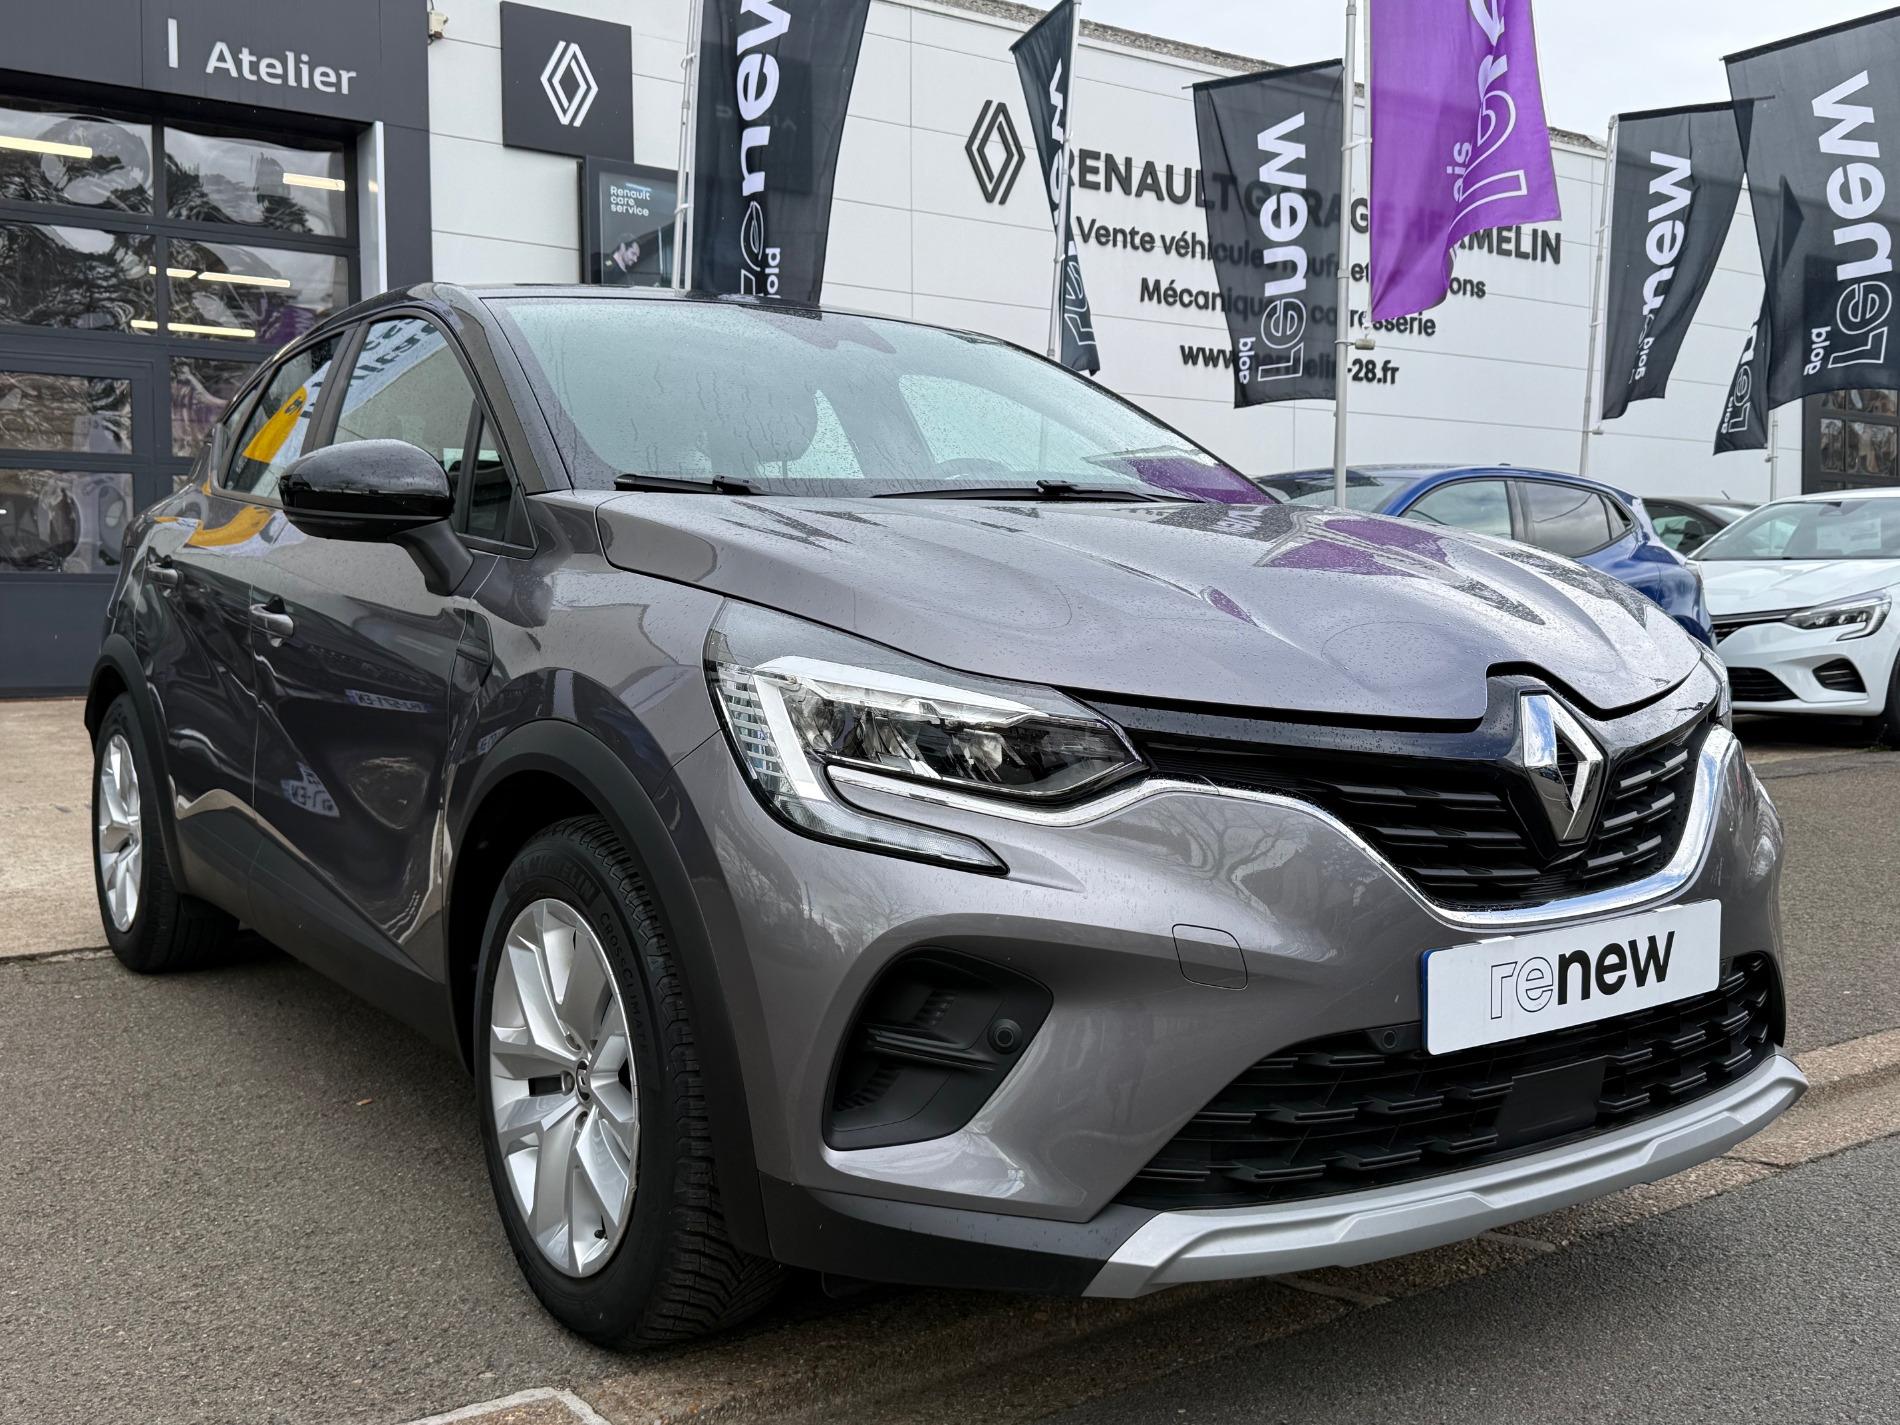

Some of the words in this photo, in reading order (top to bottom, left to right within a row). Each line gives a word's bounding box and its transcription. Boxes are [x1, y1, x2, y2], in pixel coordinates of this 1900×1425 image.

[205, 41, 357, 95] Atelier
[610, 185, 651, 201] Renault
[610, 195, 636, 207] care
[1065, 147, 1238, 212] ENAULT
[610, 203, 650, 217] service
[1076, 216, 1156, 253] Vente
[764, 247, 781, 298] old
[1490, 930, 1676, 1020] renew
